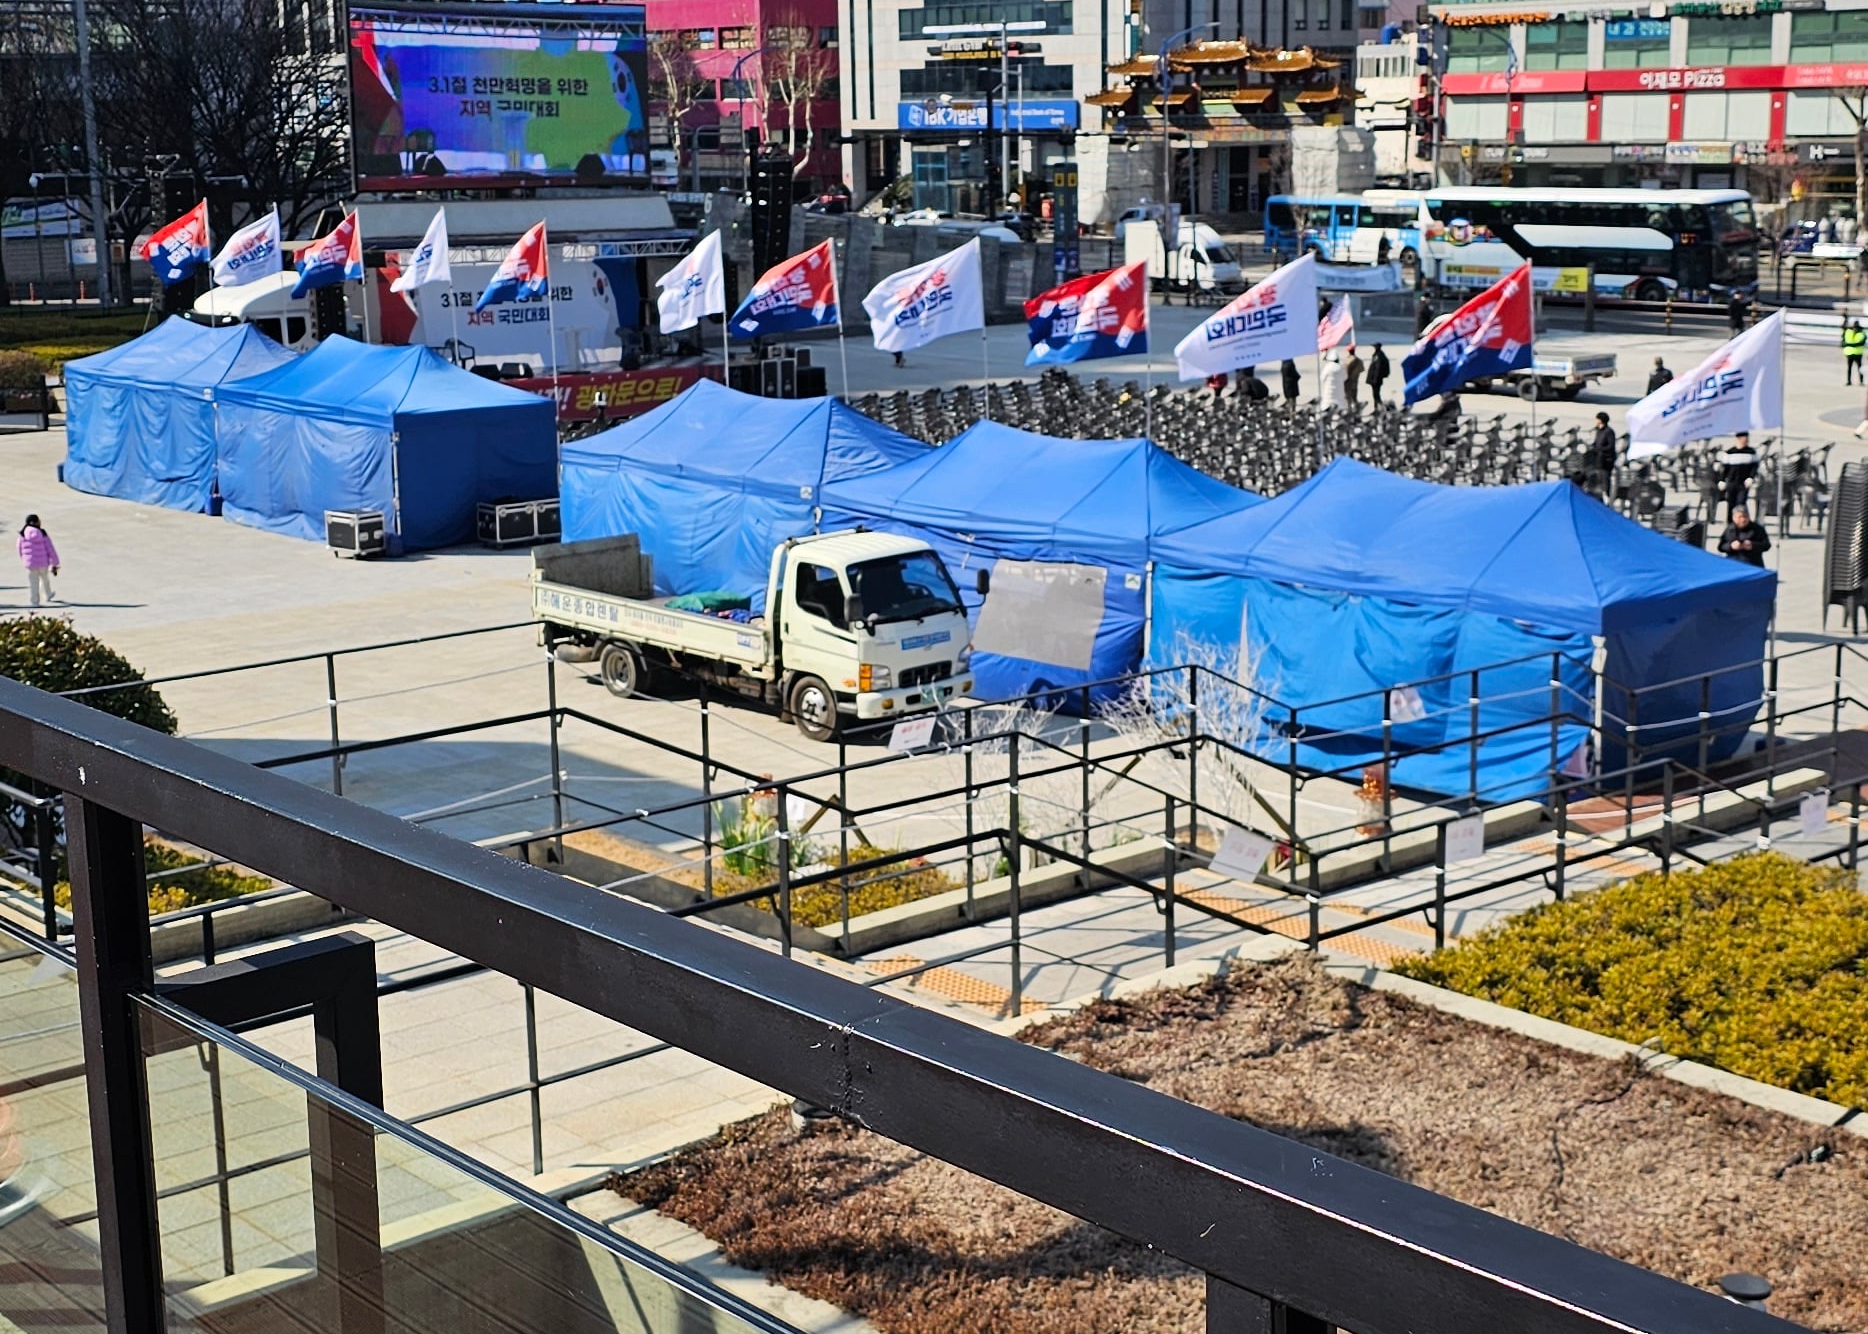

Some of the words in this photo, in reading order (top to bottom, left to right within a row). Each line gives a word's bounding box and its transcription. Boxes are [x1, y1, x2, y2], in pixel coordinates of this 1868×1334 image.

[428, 76, 467, 95] 3.1절
[473, 76, 552, 95] 천만혁명을
[557, 77, 588, 96] 위한
[1640, 71, 1681, 89] 이재모
[1684, 71, 1725, 87] Pizza
[460, 100, 492, 120] 지역
[441, 291, 472, 308] 31절
[467, 311, 494, 326] 지역
[498, 307, 550, 325] 국민대회
